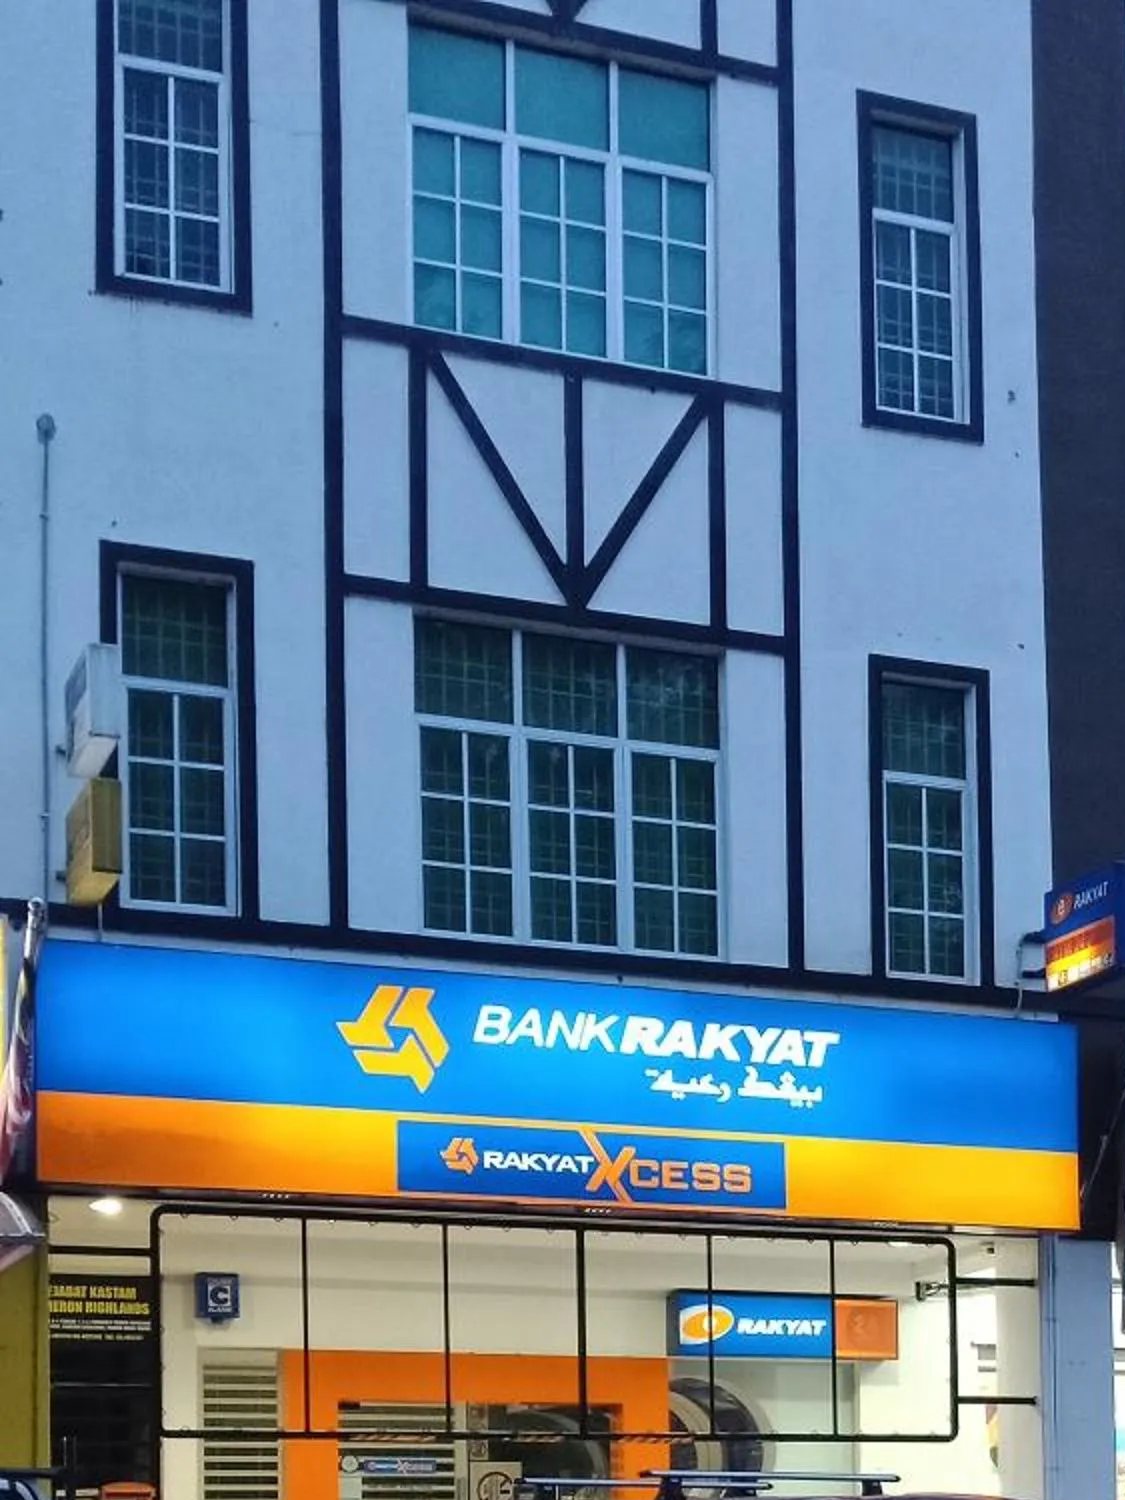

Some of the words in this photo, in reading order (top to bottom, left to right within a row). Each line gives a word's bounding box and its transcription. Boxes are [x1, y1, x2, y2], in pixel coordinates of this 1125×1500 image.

[1073, 881, 1109, 910] RAKYAT
[473, 1004, 619, 1052] BANK
[619, 1016, 841, 1068] RAKYAT
[482, 1150, 595, 1175] RAKYAT
[581, 1128, 753, 1203] XCESS
[89, 1285, 137, 1300] KASTAM
[85, 1301, 150, 1316] HIGHLANDS
[736, 1317, 828, 1337] RAKYAT
